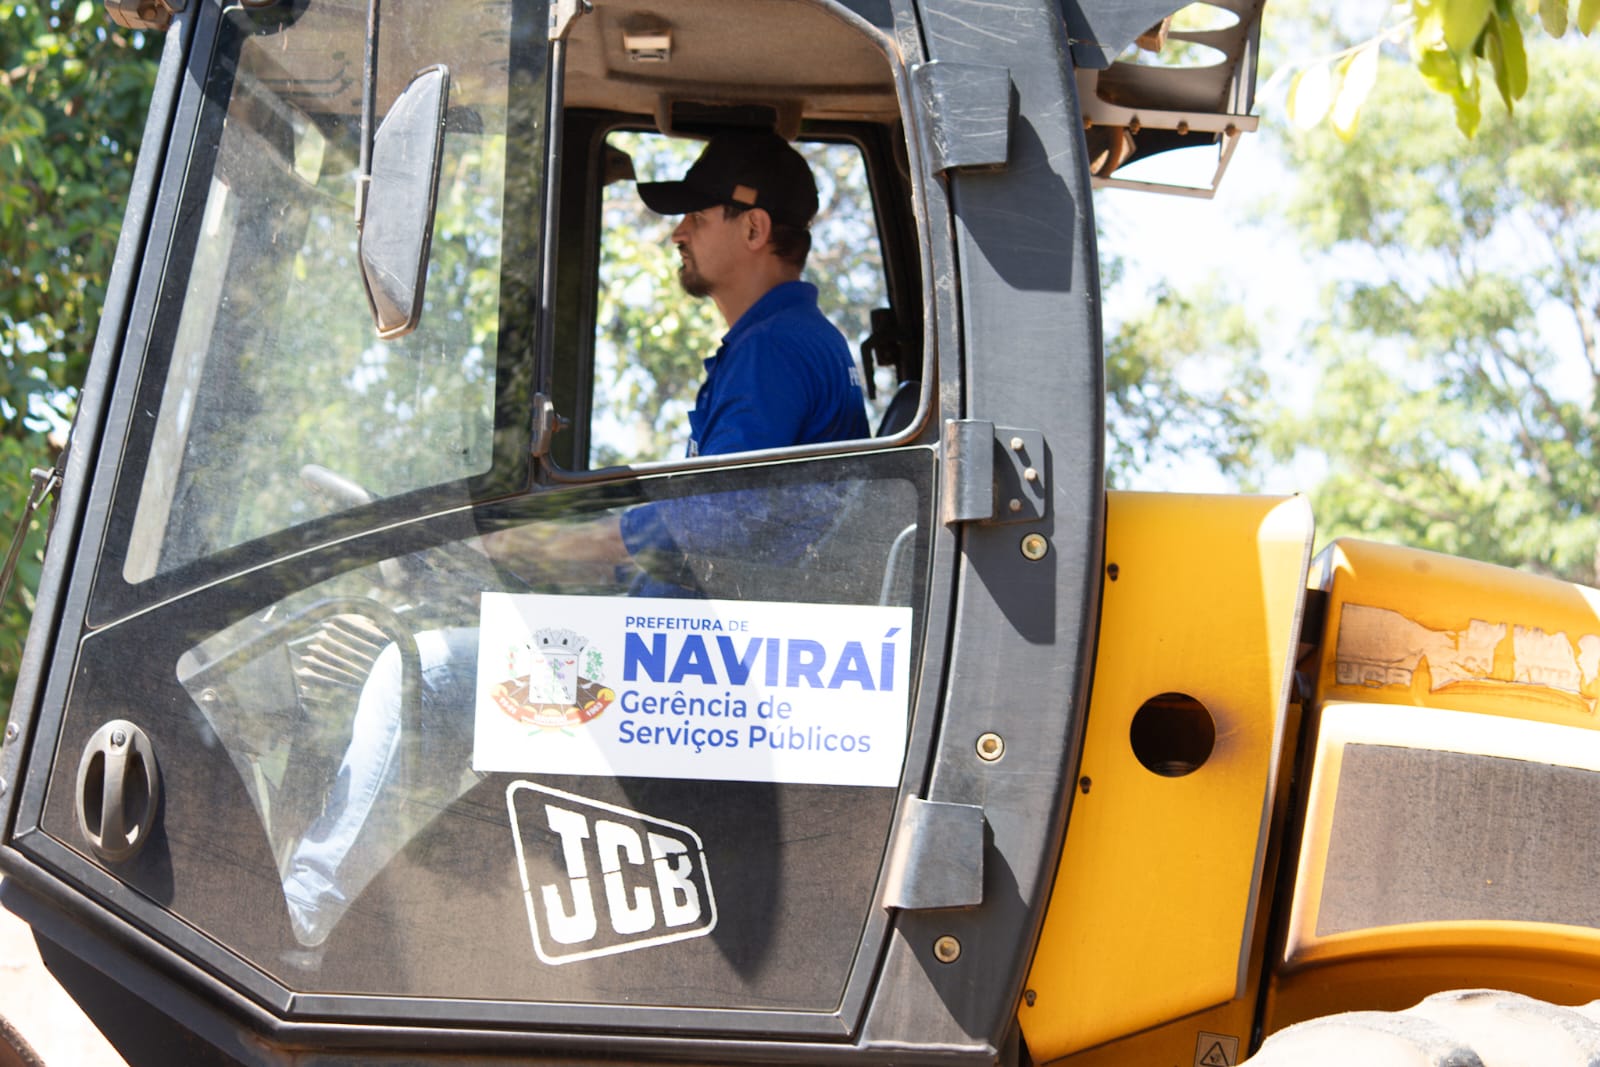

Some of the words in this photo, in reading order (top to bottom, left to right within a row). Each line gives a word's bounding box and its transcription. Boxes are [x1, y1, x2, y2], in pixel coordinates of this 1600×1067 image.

[624, 614, 724, 633] PREFEITURA
[728, 619, 749, 632] DE
[622, 627, 902, 692] NAVIRAÍ
[620, 688, 747, 719] Gerência
[756, 694, 793, 720] de
[618, 719, 740, 753] Serviços
[747, 722, 872, 752] Públicos
[541, 804, 702, 944] JCB
